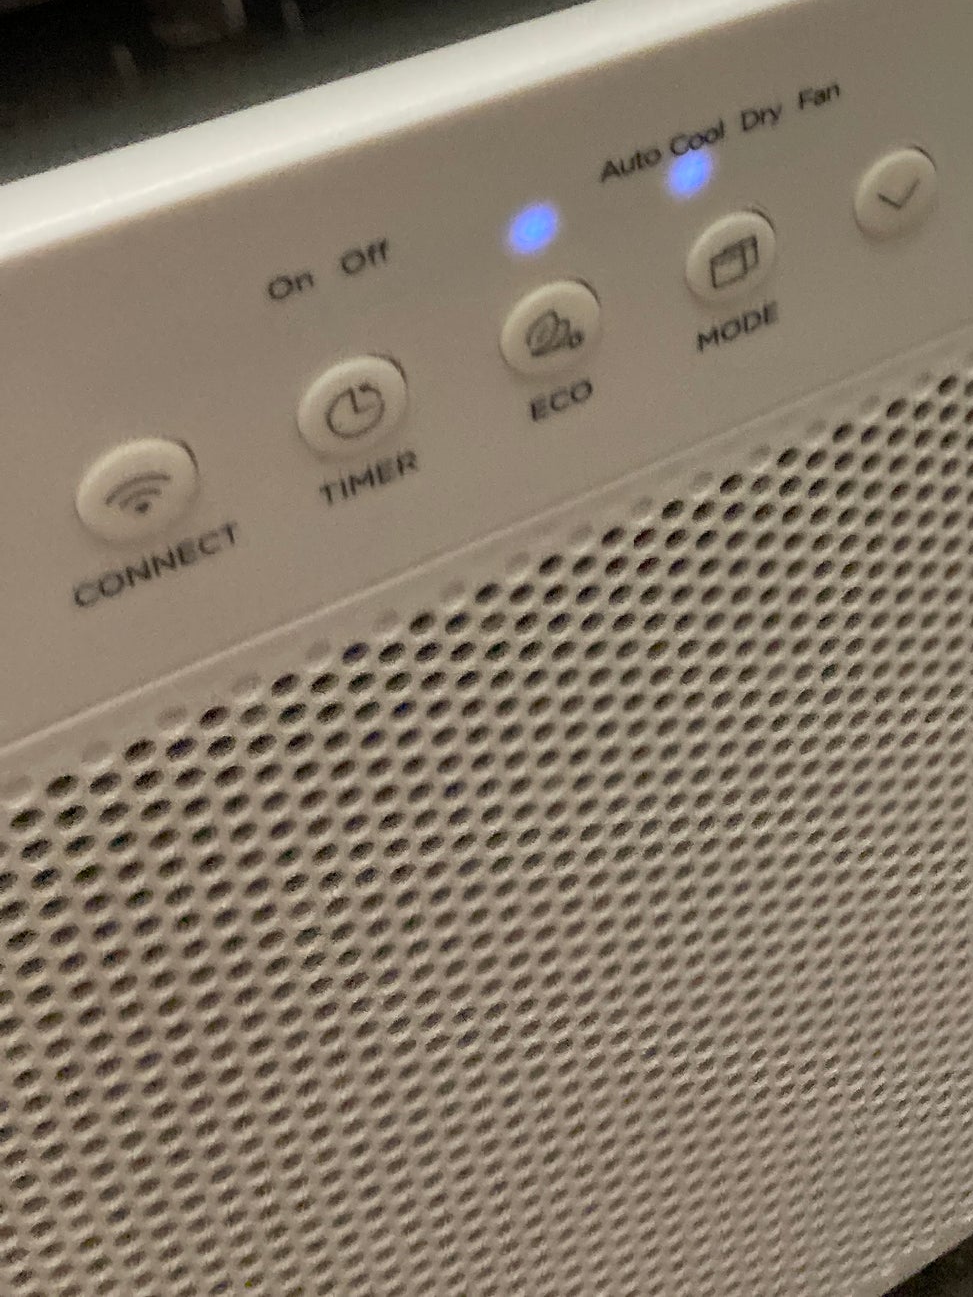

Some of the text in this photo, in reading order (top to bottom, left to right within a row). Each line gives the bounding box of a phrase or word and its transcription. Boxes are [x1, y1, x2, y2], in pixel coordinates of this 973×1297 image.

[600, 82, 842, 183] Auto Cool Dry Fan
[267, 238, 390, 302] On Off
[696, 301, 779, 354] MODE
[530, 378, 594, 423] ECO
[318, 450, 419, 507] TIMER
[73, 521, 240, 608] CONNECT
